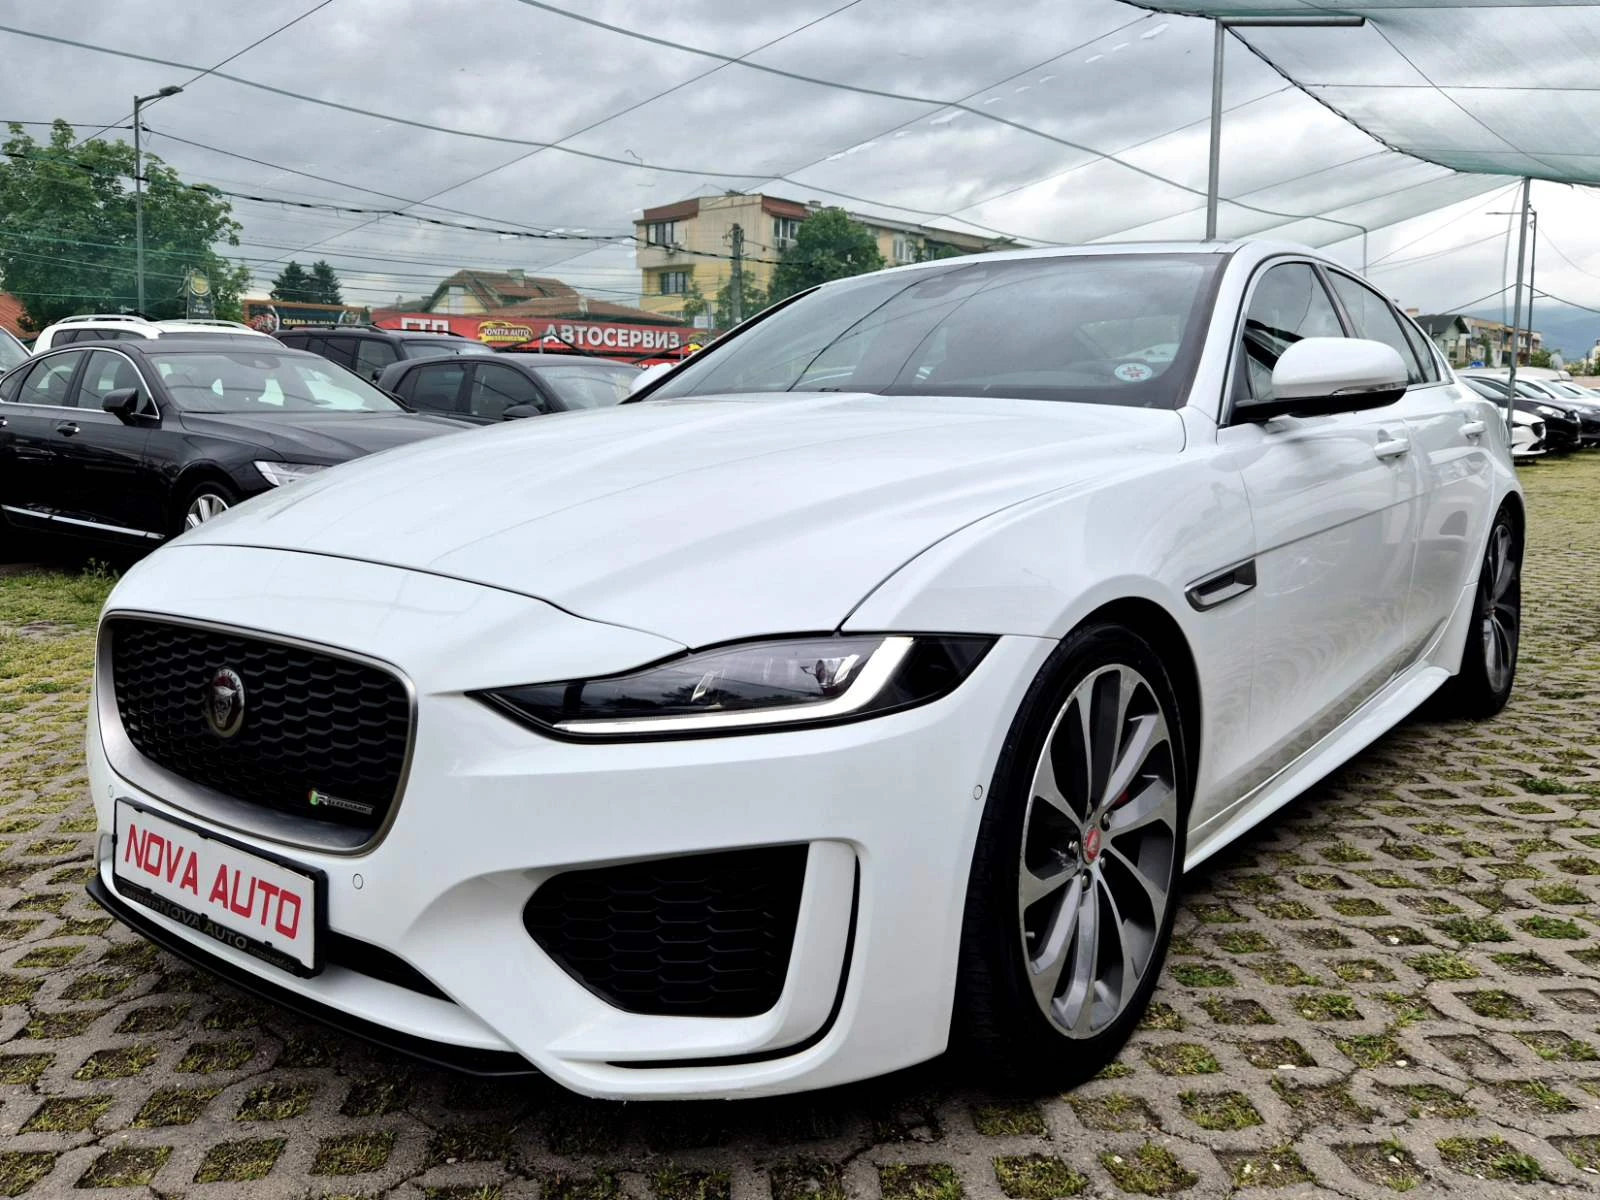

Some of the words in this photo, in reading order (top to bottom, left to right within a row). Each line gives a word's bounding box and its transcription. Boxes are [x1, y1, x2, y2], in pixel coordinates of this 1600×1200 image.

[510, 329, 529, 337] AUTO
[543, 323, 680, 349] АВТОСЕРВИЗ
[124, 823, 199, 897] NOVA
[208, 863, 302, 941] AUTO
[159, 900, 201, 930] NOVA
[203, 922, 248, 950] AUTO
